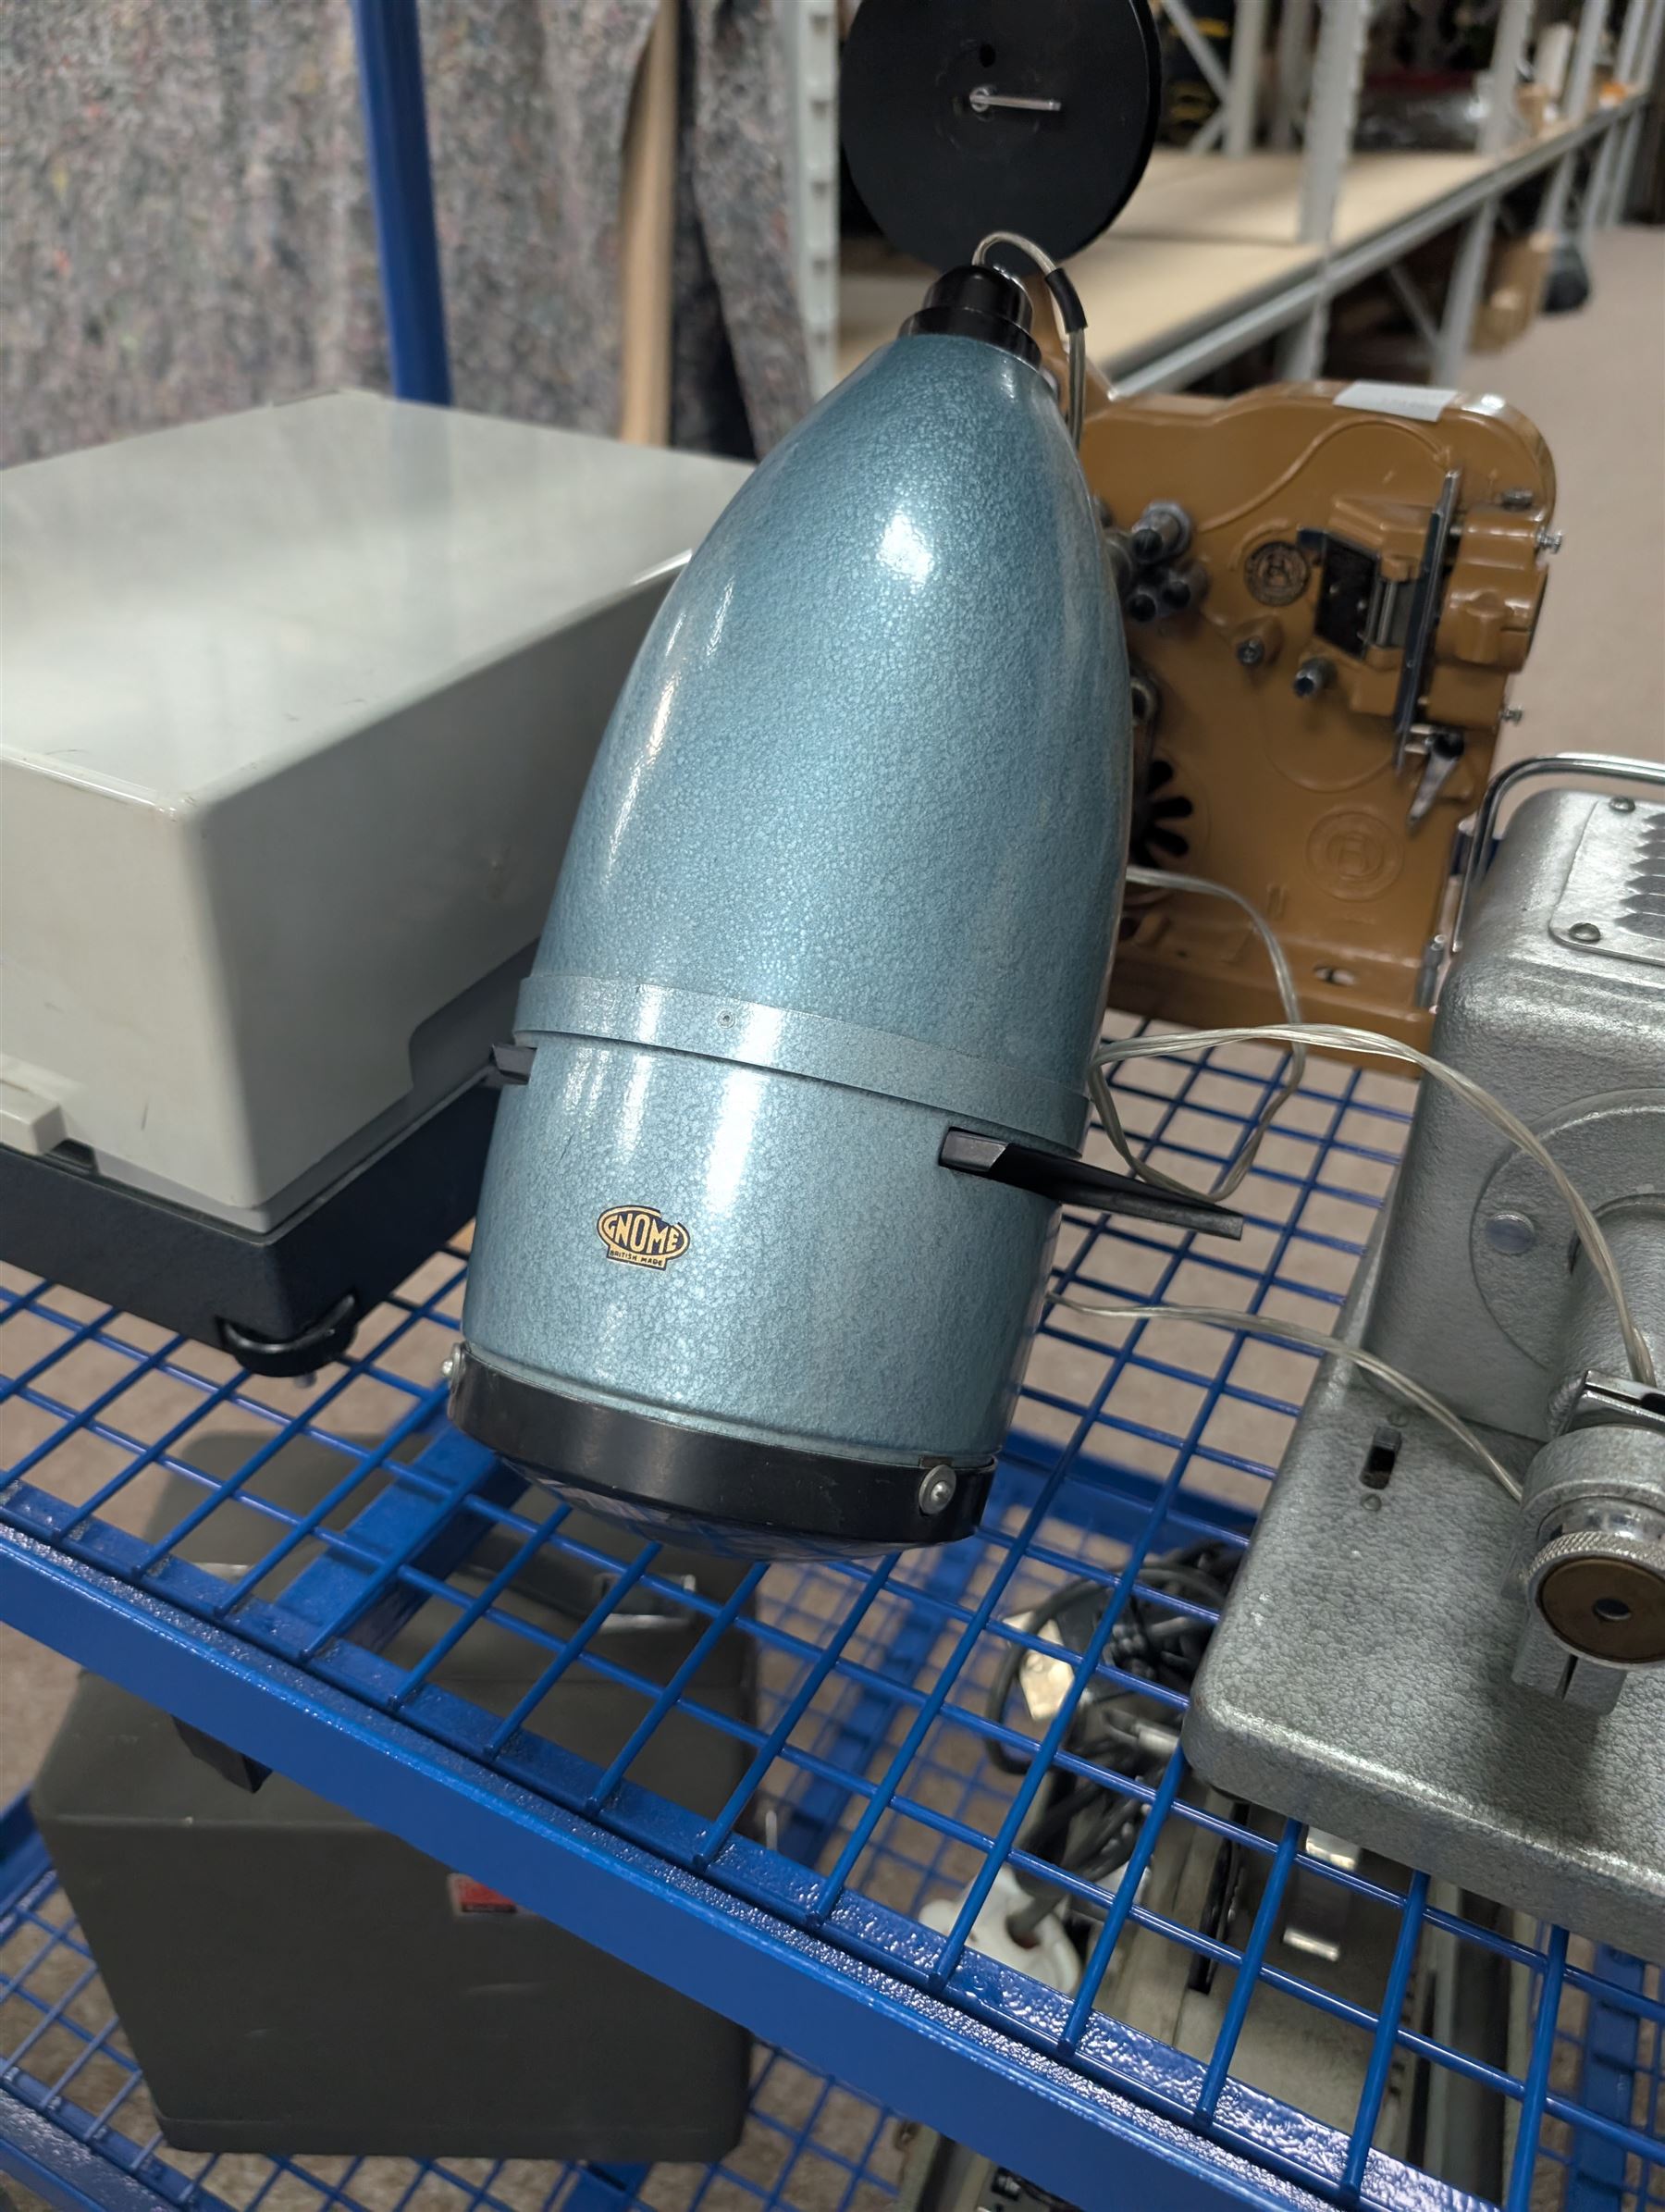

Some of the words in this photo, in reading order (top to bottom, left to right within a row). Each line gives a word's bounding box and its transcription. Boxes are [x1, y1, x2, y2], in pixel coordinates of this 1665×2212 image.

[603, 1213, 680, 1254] GNOME
[610, 1250, 637, 1261] BRITISH
[641, 1257, 663, 1266] MADE
